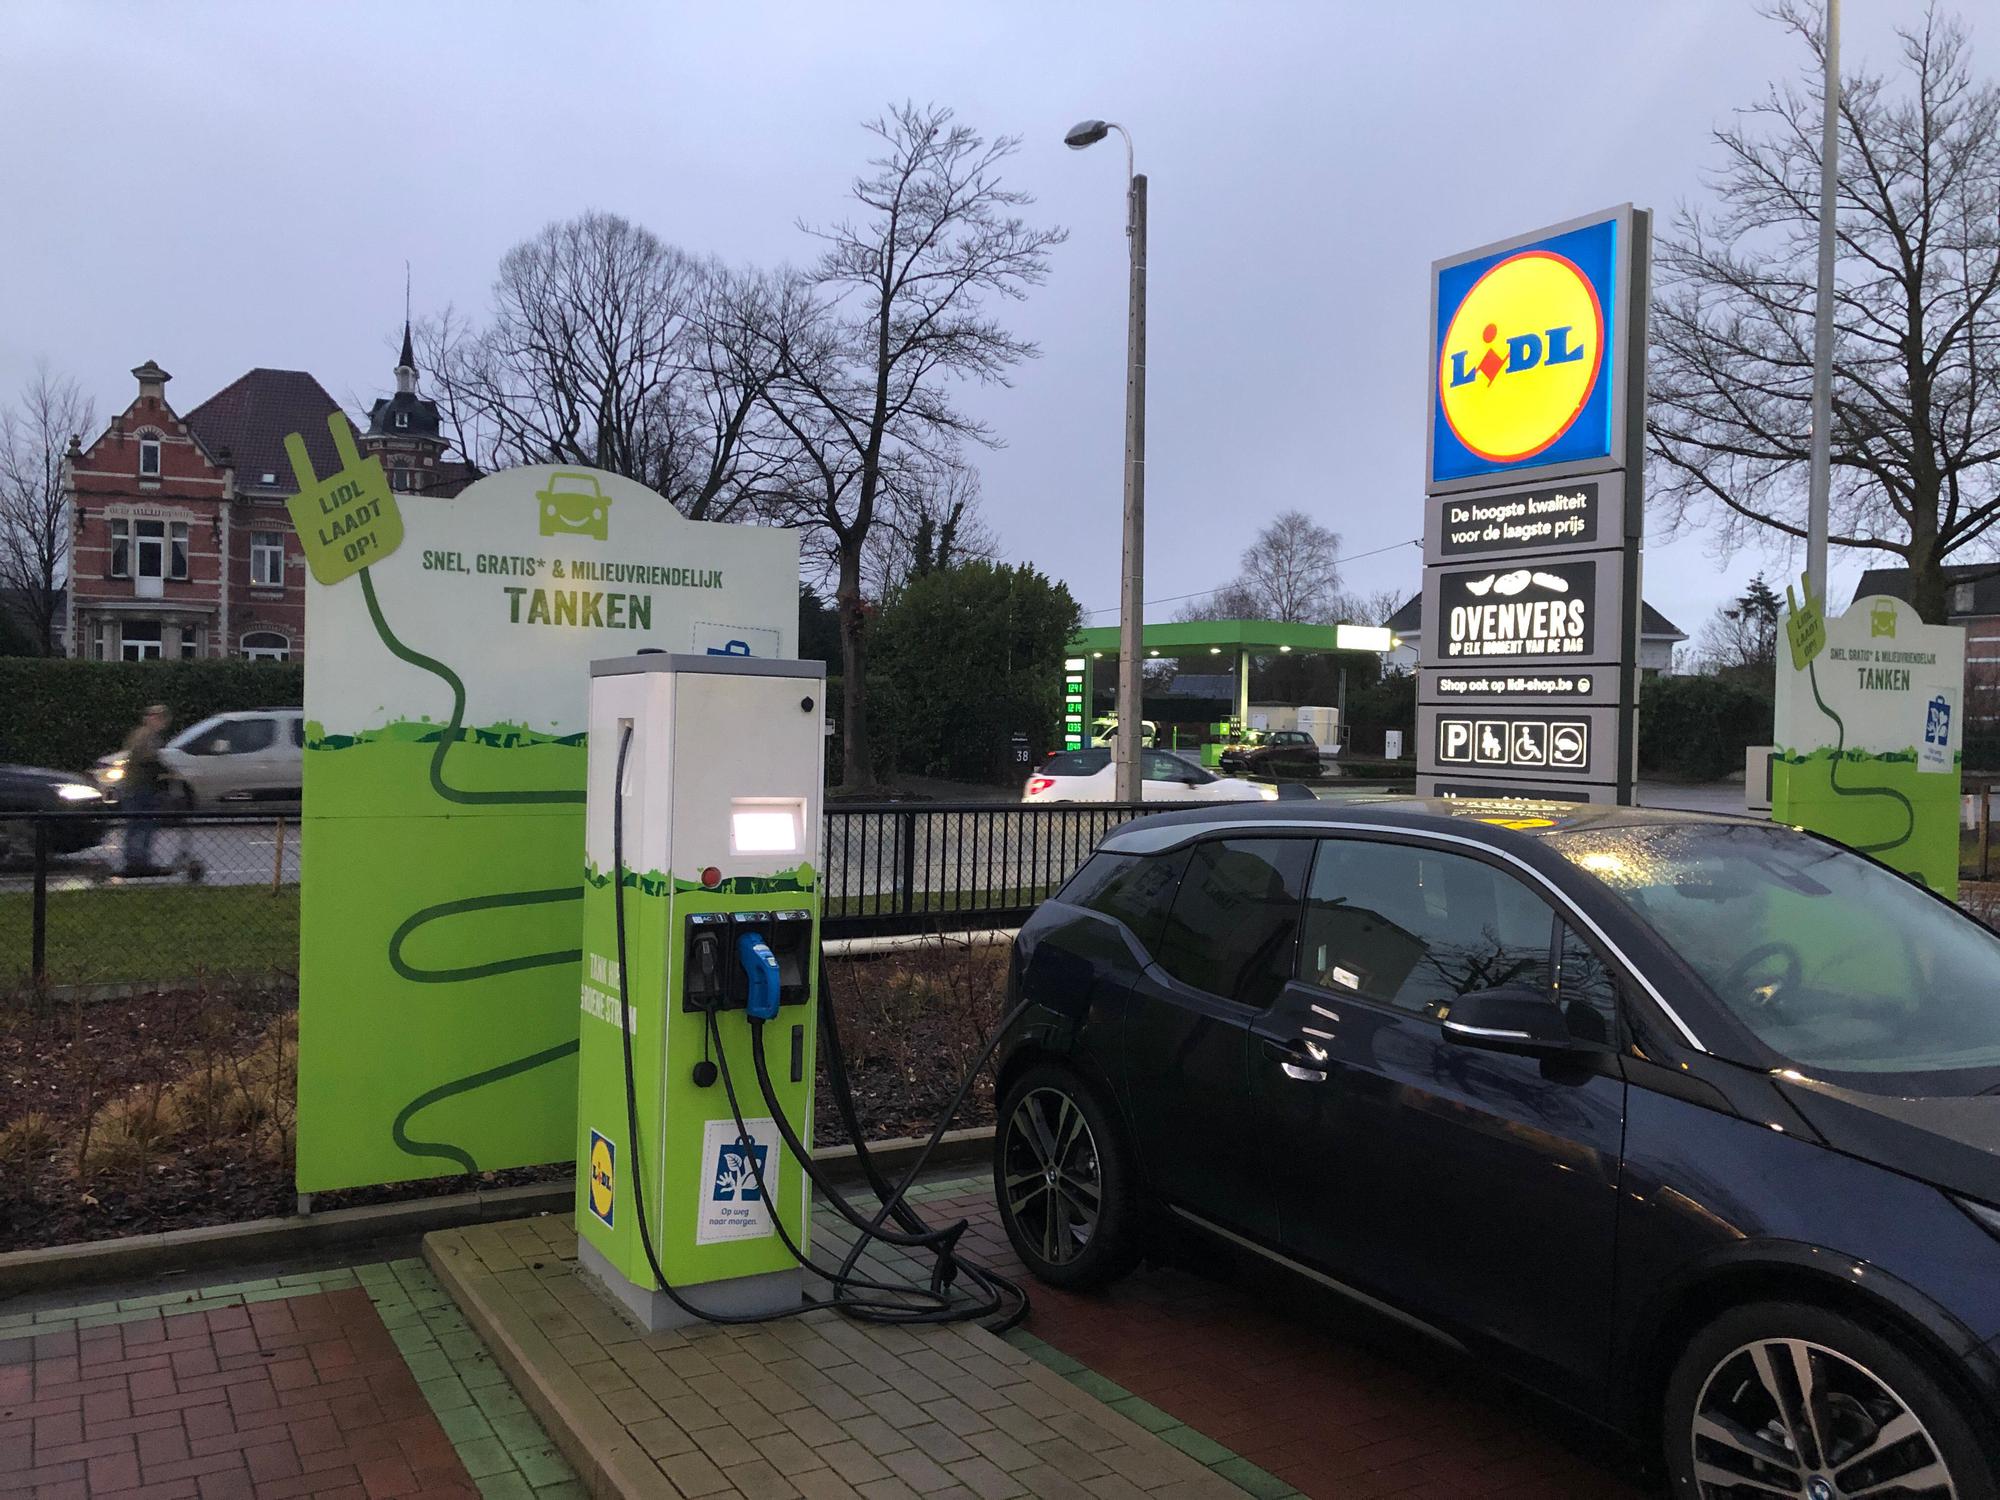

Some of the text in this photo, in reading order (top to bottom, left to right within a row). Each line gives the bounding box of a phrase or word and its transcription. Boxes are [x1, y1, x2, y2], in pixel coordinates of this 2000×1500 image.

[319, 480, 365, 515] LIDL
[1451, 493, 1587, 523] De hoogste kwaliteit
[319, 498, 381, 546] LAADT
[1451, 516, 1585, 544] voor de laagste prijs
[343, 531, 378, 562] OP!
[422, 550, 470, 575] SNEL,
[552, 559, 565, 578] &
[571, 560, 723, 589] MILIEUVRIENDELIJK
[503, 587, 652, 630] TANKEN
[1450, 599, 1585, 642] OVENVERS
[1449, 638, 1584, 656] OP ELK MOMENT VAN DE DAG
[1440, 678, 1573, 693] Shop ook op lidl-shop.be
[1857, 667, 1910, 691] TANKEN
[1448, 724, 1467, 757] P
[1016, 750, 1029, 762] 38
[760, 913, 768, 921] 2
[800, 911, 807, 919] 3
[709, 1218, 728, 1226] naar
[721, 1207, 749, 1218] Op weg
